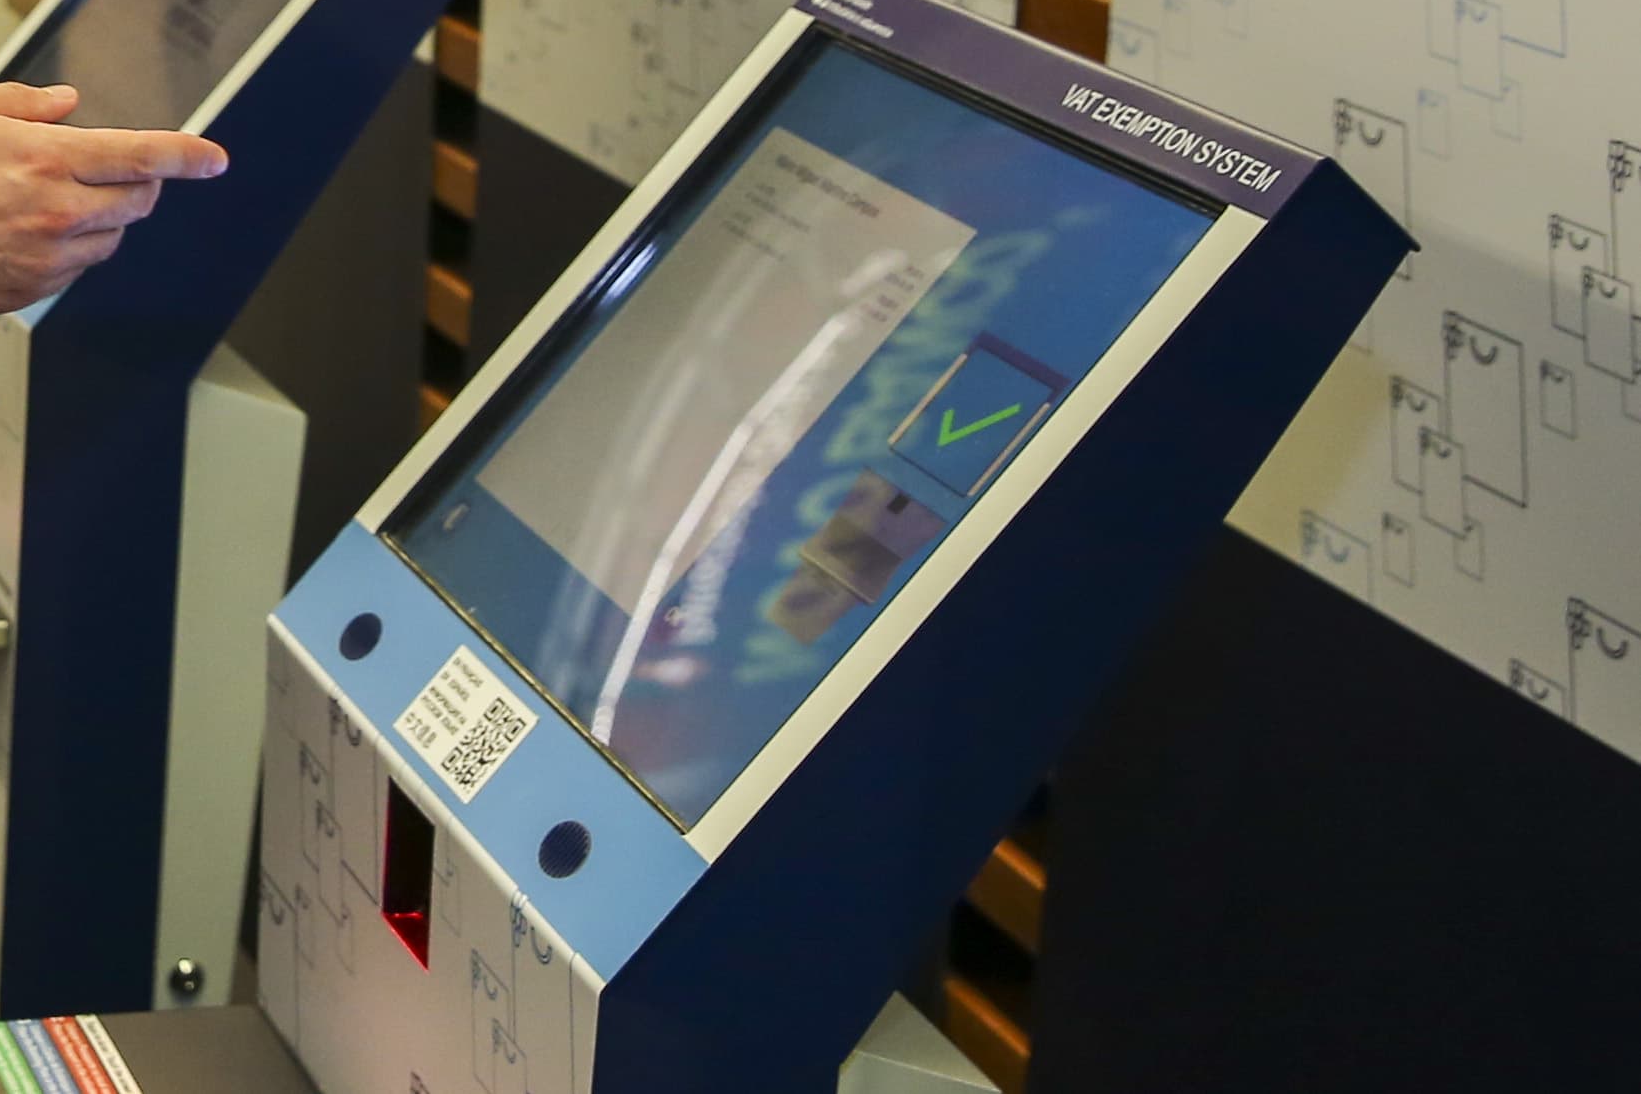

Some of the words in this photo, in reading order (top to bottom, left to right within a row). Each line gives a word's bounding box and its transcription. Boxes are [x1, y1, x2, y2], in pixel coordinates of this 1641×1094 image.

[1061, 83, 1105, 115] VAT
[1091, 97, 1203, 158] EXEMPTION
[1192, 140, 1283, 194] SYSTEM
